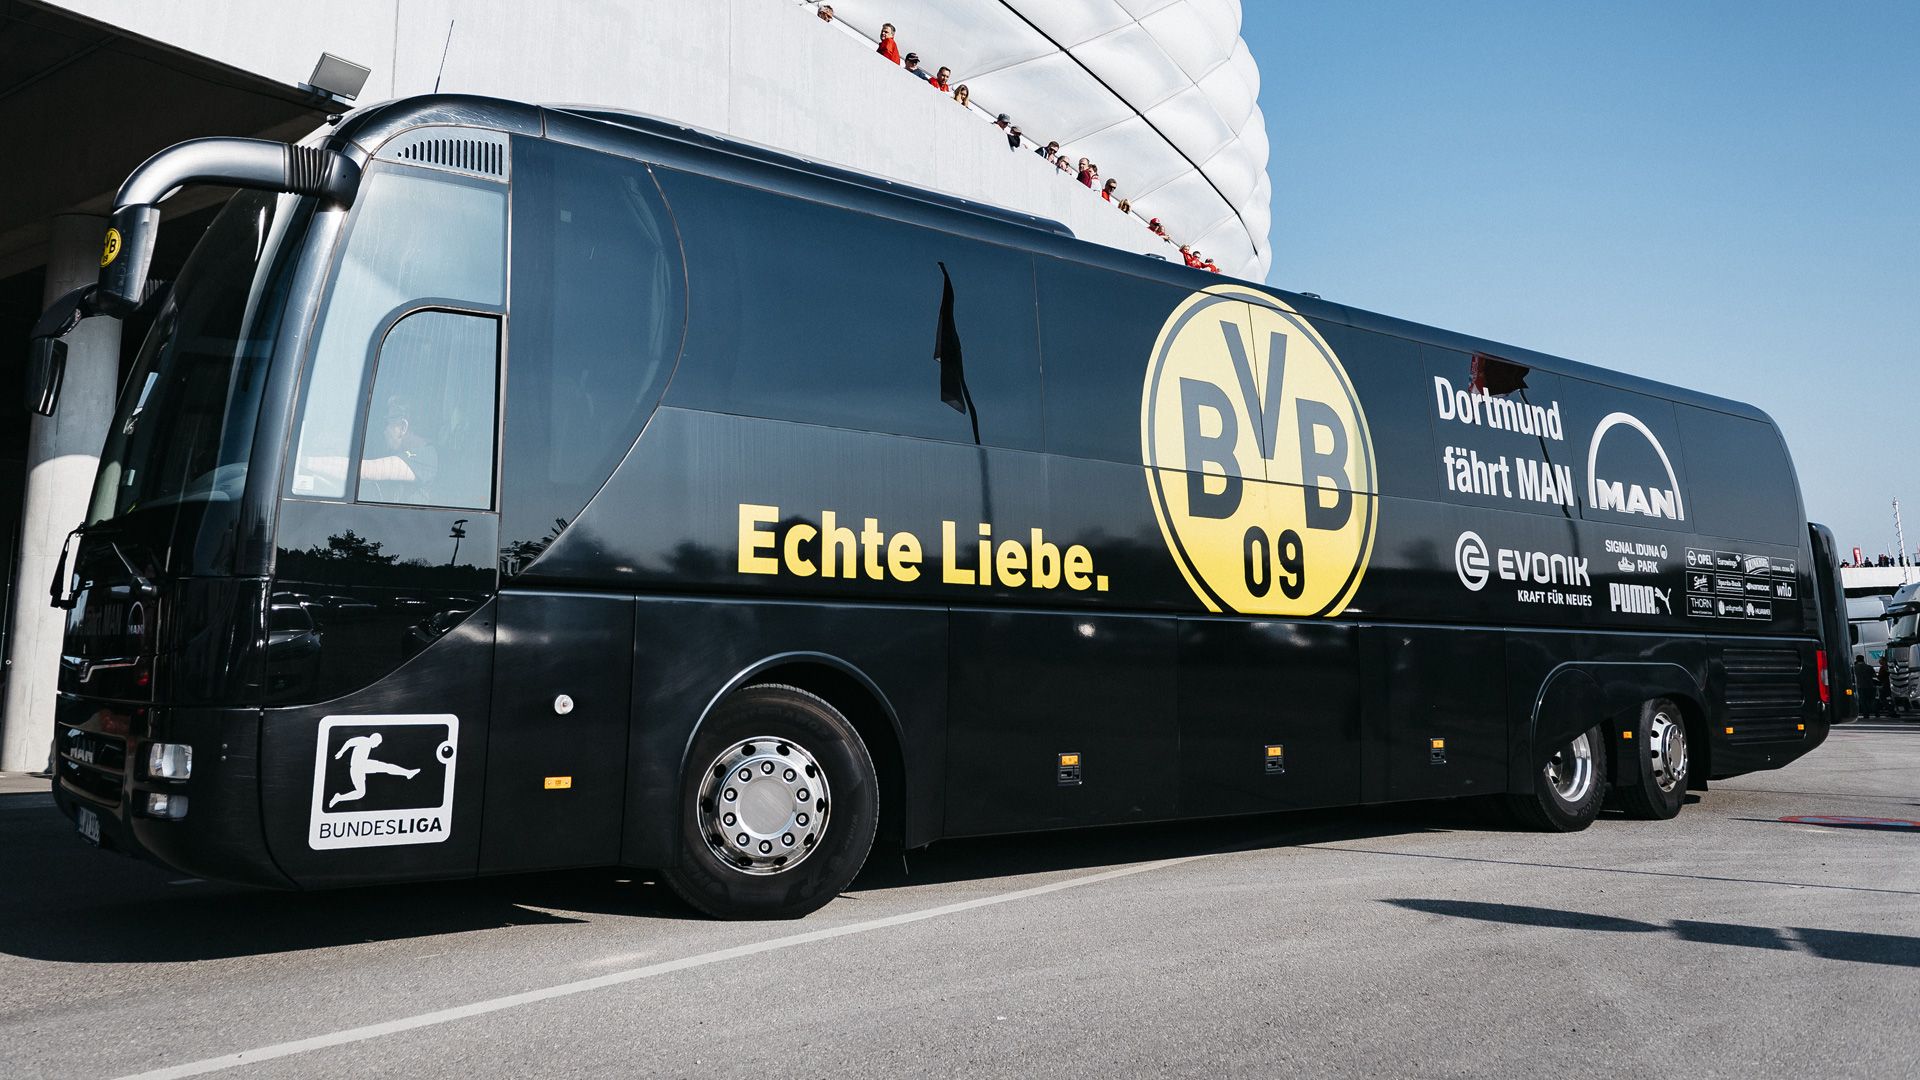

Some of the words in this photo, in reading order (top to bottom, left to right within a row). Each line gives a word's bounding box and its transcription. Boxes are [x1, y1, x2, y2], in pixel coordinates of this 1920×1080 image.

[1434, 376, 1564, 441] Dortmund
[1179, 320, 1353, 532] BVB
[1443, 445, 1513, 499] fährt
[1515, 457, 1575, 507] MAN
[1596, 478, 1676, 520] MAN
[737, 503, 923, 583] Echte
[941, 520, 1110, 592] Liebe.
[1605, 539, 1635, 556] SIGNAL
[1635, 543, 1661, 558] IDUNA
[1698, 554, 1713, 565] OPEL
[1243, 525, 1306, 600] 09
[1497, 548, 1592, 587] EVONIK
[1637, 559, 1659, 574] PARK
[1517, 589, 1546, 604] KRAFT
[1547, 589, 1564, 605] FÜR
[1565, 593, 1593, 607] NEUES
[1609, 582, 1656, 614] PUMA
[1691, 598, 1712, 608] THORN
[1777, 582, 1792, 597] wilo
[70, 747, 94, 764] MAN
[319, 817, 443, 840] BUNDESLIGA
